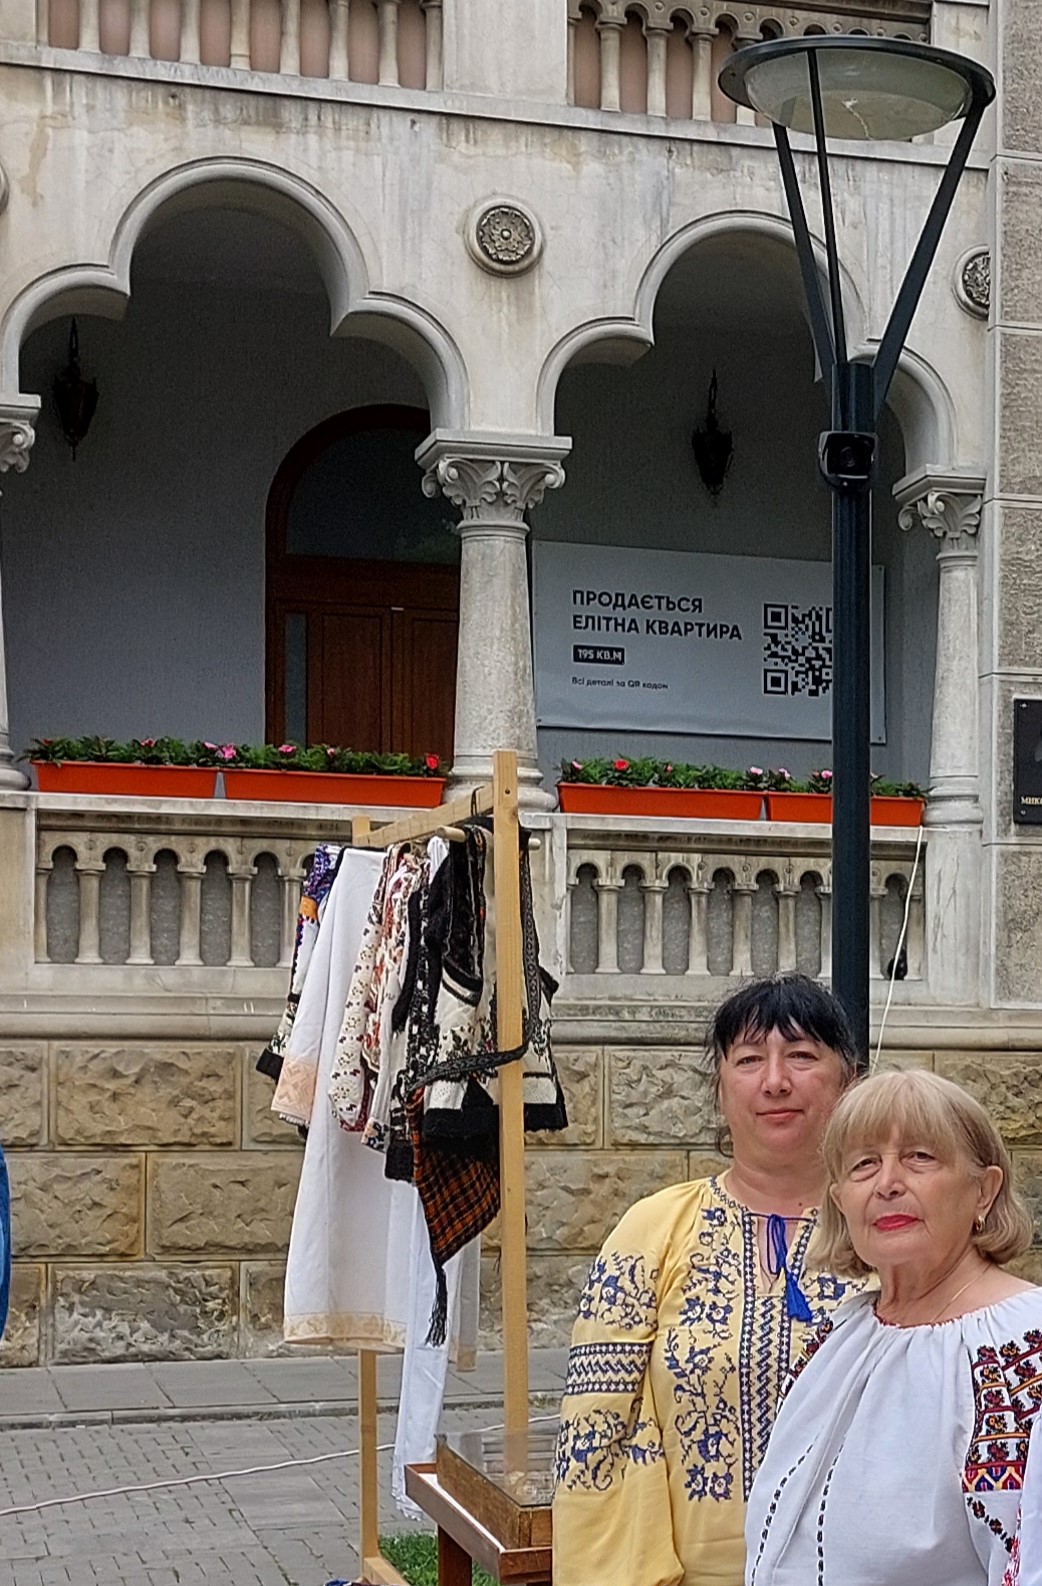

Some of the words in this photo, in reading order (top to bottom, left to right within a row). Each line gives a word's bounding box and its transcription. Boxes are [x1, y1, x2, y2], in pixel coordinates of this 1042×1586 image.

[572, 589, 703, 614] ПРОДАЄТЬСЯ
[572, 614, 640, 634] ЕЛІТНА
[645, 619, 743, 641] КВАРТИРА
[577, 648, 594, 660] 195
[627, 680, 641, 688] QR
